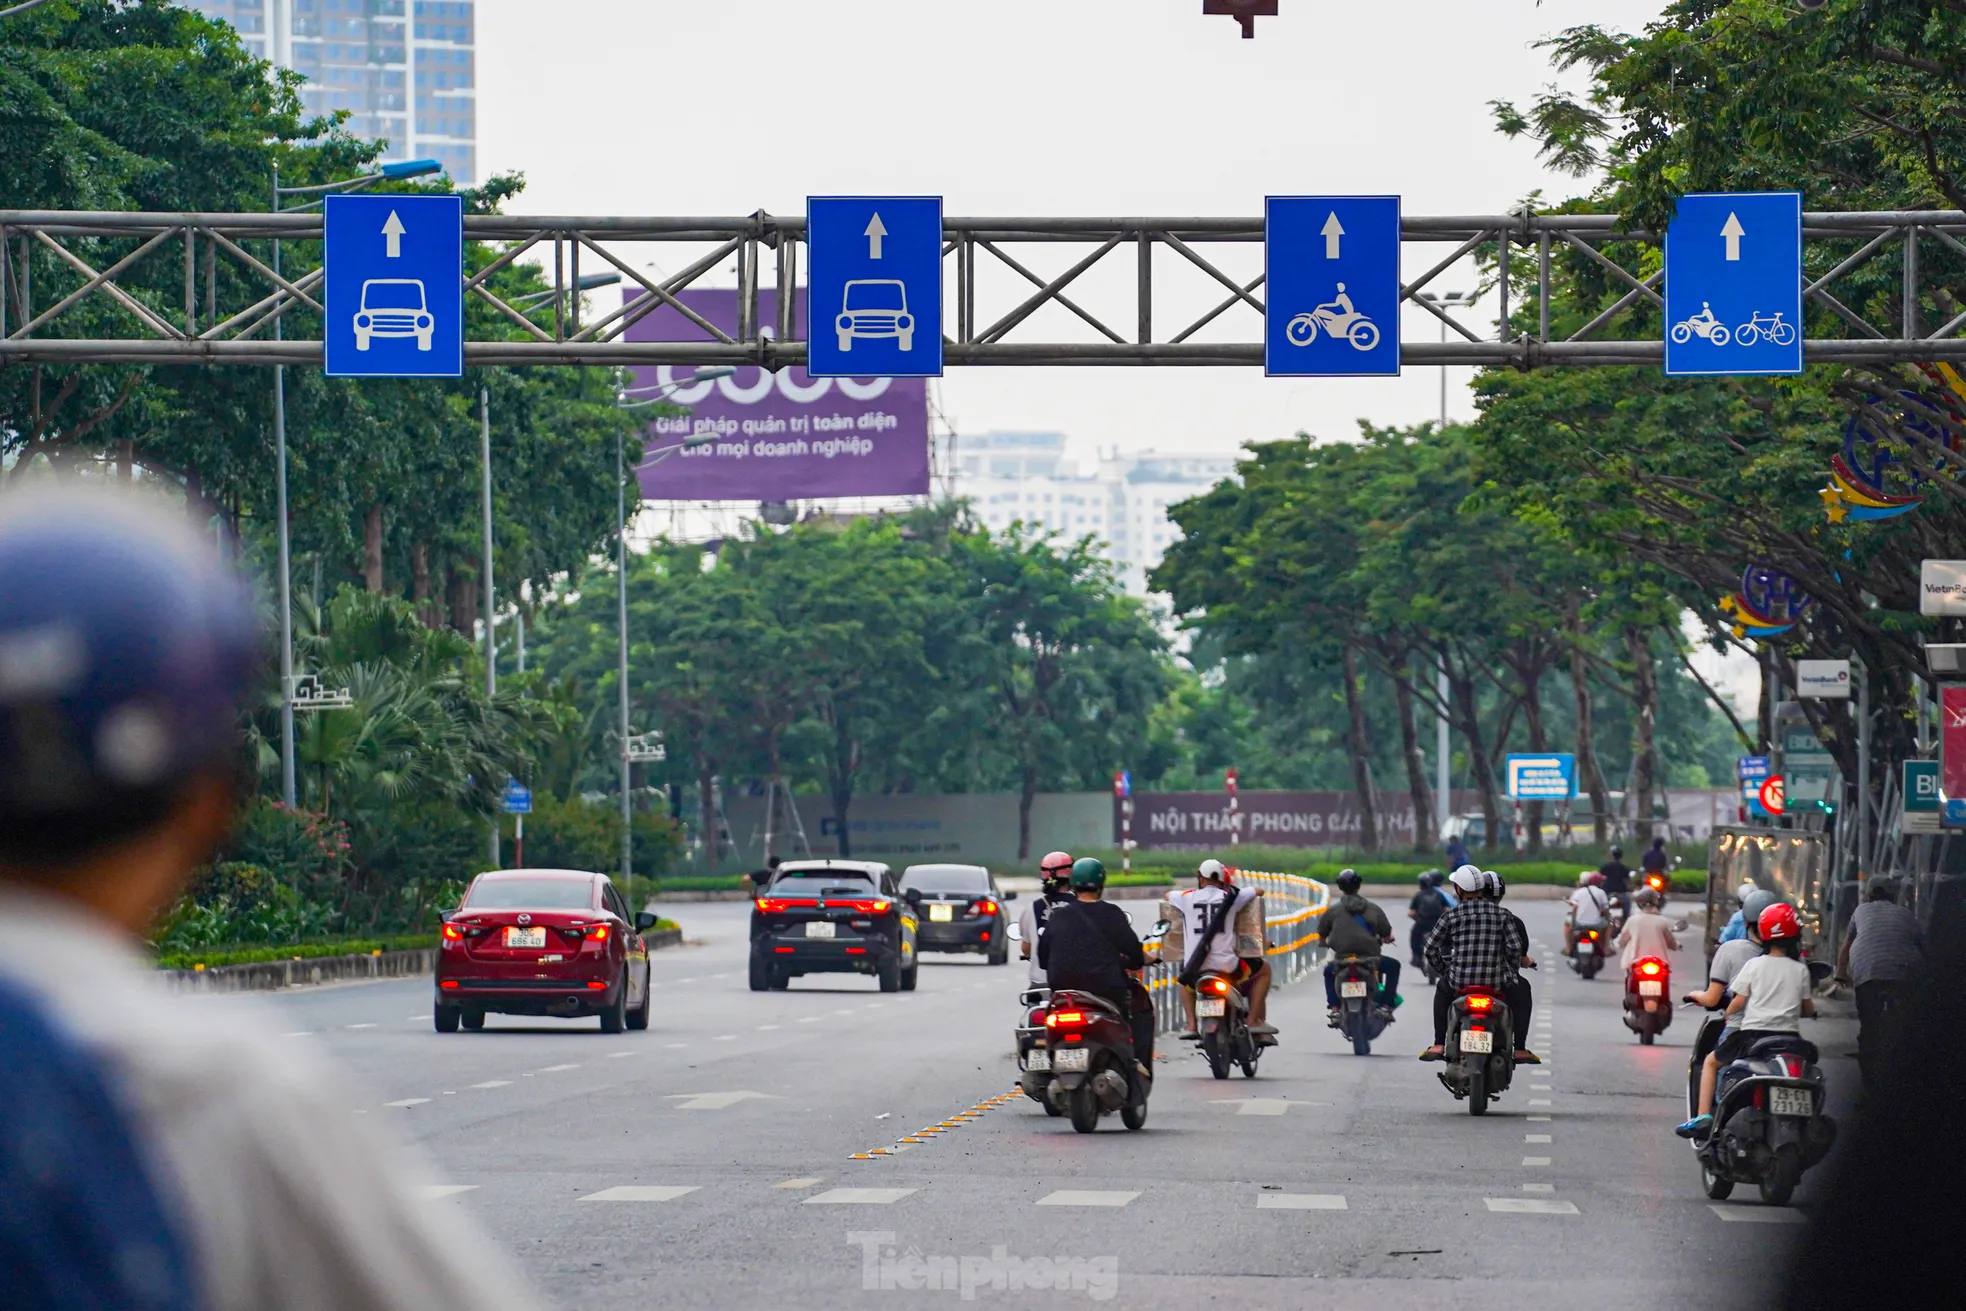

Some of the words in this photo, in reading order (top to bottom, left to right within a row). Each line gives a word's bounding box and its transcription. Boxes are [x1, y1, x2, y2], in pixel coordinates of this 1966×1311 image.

[695, 415, 737, 436] pháp
[742, 416, 786, 434] quản
[790, 415, 808, 433] trị
[813, 413, 853, 431] toàn
[858, 412, 897, 431] diện
[718, 440, 749, 459] mọi
[754, 439, 808, 457] doanh
[813, 437, 873, 458] nghiệp
[1151, 806, 1187, 835] NỘI
[1250, 811, 1322, 833] PHONG
